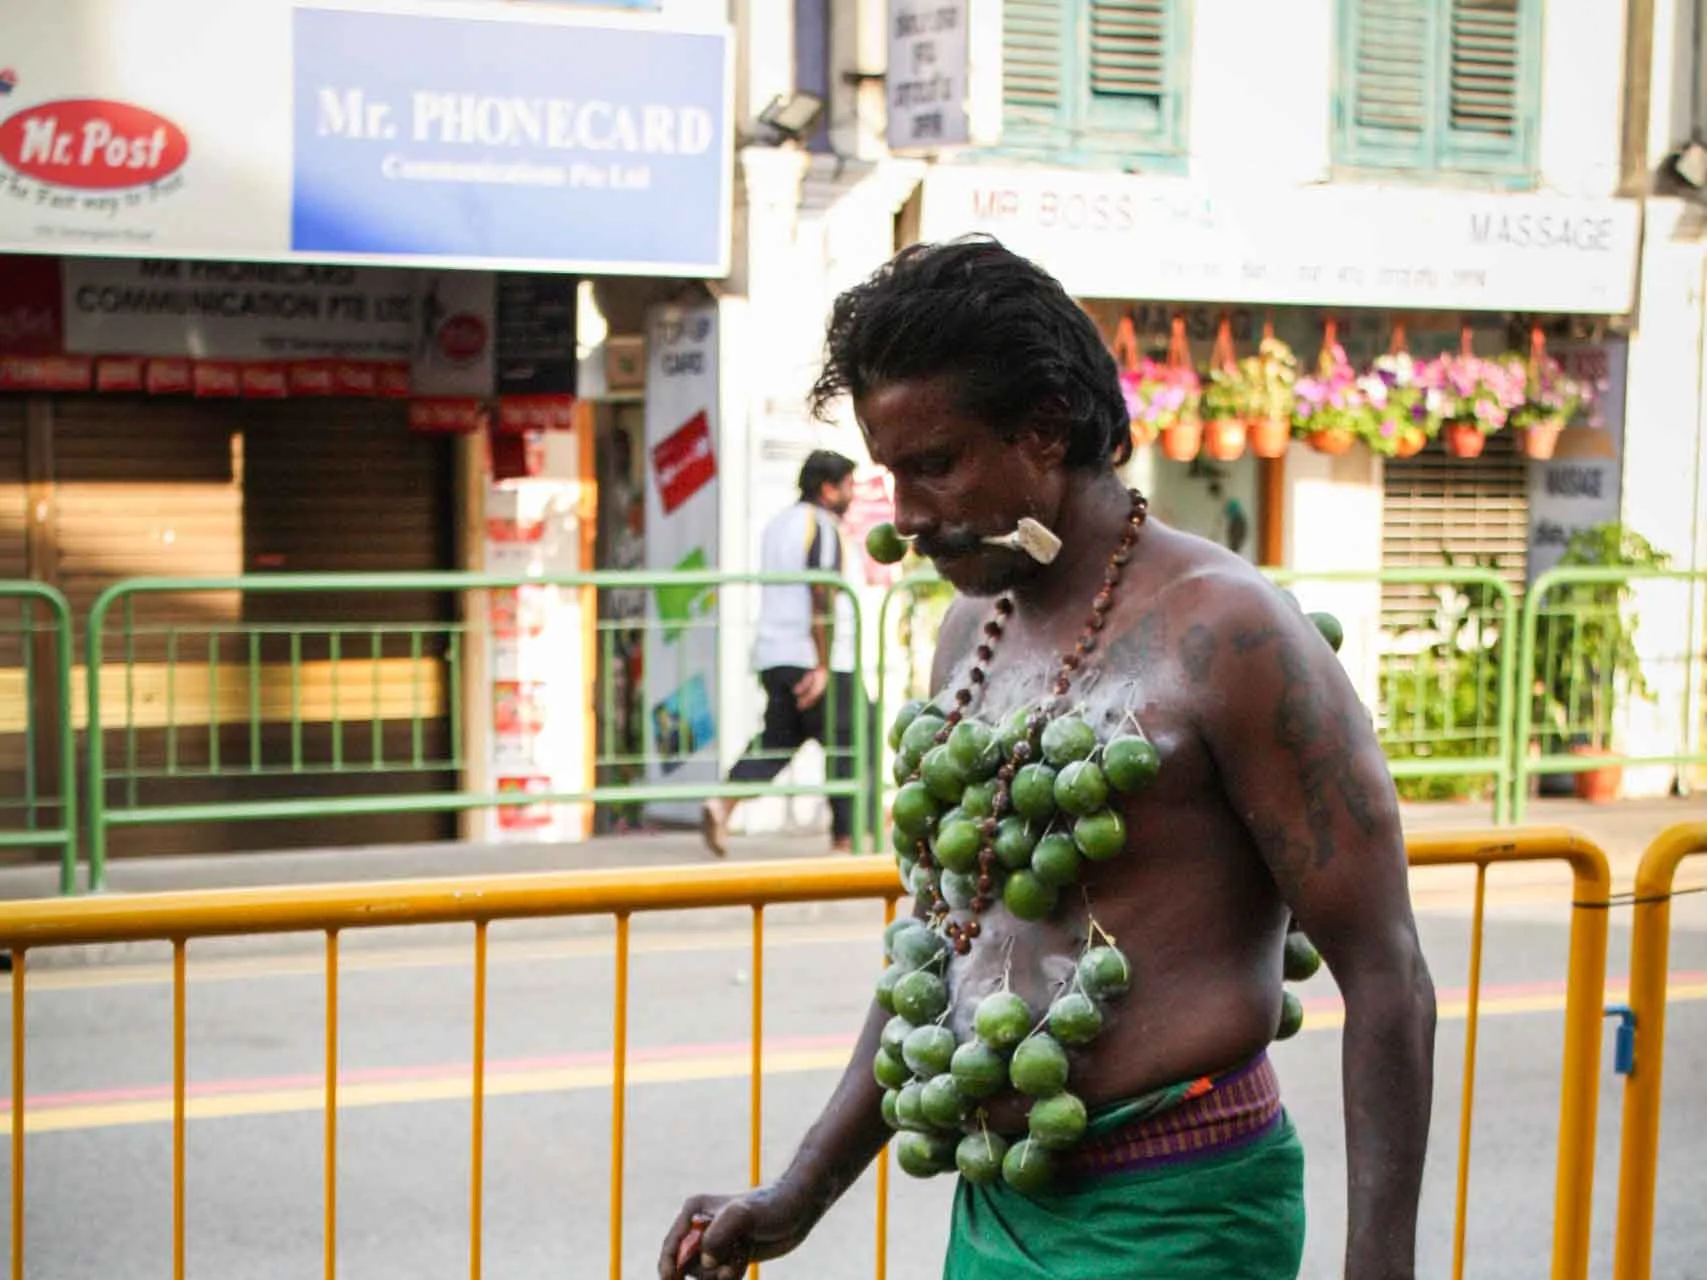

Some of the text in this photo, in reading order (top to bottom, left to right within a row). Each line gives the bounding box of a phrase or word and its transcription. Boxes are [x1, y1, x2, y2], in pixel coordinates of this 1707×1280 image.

[317, 88, 713, 156] Mr. PHONECARD
[78, 118, 168, 169] Post
[1037, 190, 1137, 231] BOSS
[1469, 212, 1614, 253] MASSAGE
[76, 285, 320, 318] COMMUNICATION
